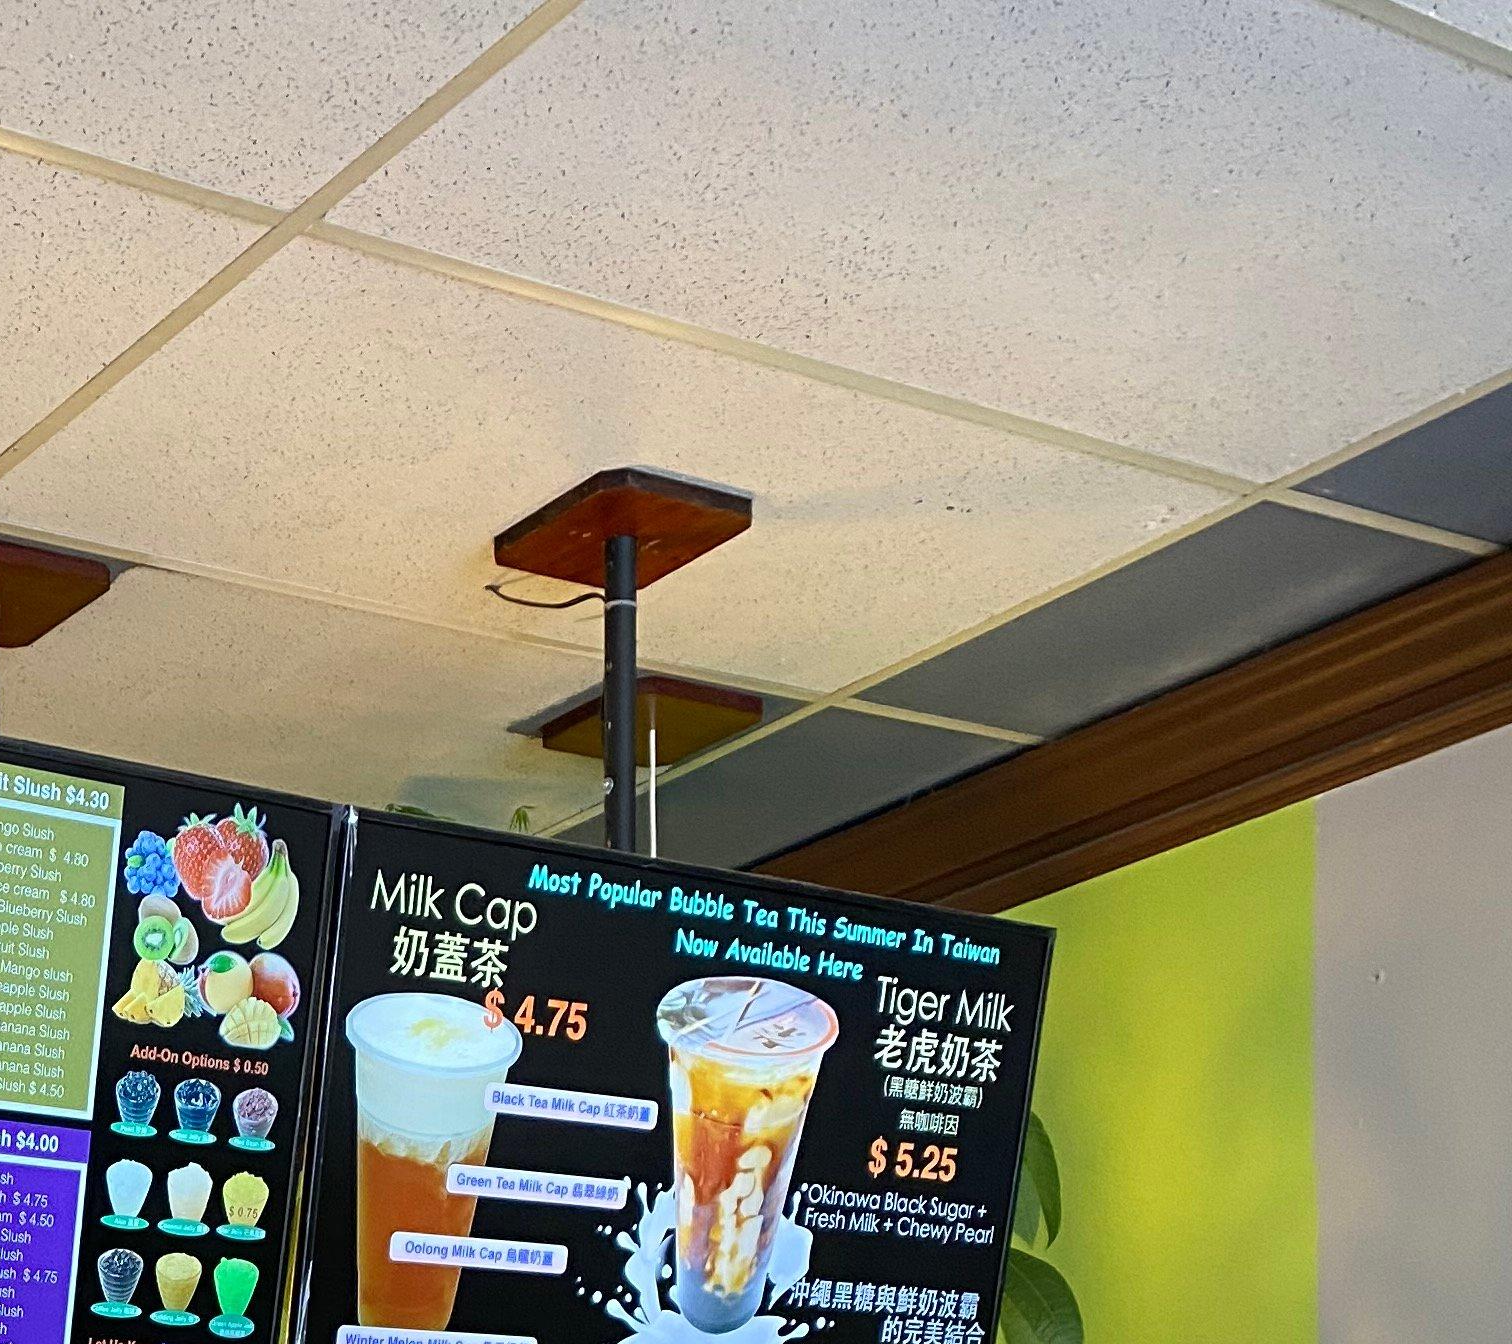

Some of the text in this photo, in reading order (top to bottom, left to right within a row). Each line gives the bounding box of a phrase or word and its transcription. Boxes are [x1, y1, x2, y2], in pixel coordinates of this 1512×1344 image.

[14, 775, 61, 801] Slush
[66, 786, 109, 811] $4.30
[23, 822, 54, 842] Slush
[371, 869, 537, 939] Milk Cap
[529, 865, 1000, 965] Most Popular Bubble Tea This Summer In Taiwan
[390, 926, 509, 988] 奶蓋茶
[676, 929, 863, 980] Now Available Here
[484, 988, 587, 1041] $ 4.75
[877, 976, 1015, 1032] Tiger Milk
[130, 1044, 268, 1075] Add-On Options $ 0.50
[874, 1025, 1003, 1082] 老虎奶茶
[492, 1091, 600, 1116] Black Tea Milk Cap
[16, 1130, 58, 1153] $4.00
[869, 1136, 957, 1182] $ 5.25
[805, 1210, 994, 1244] Fresh Milk + Chewy Pearl
[885, 1191, 925, 1215] Black
[931, 1197, 974, 1221] Sugar
[977, 1205, 986, 1216] +
